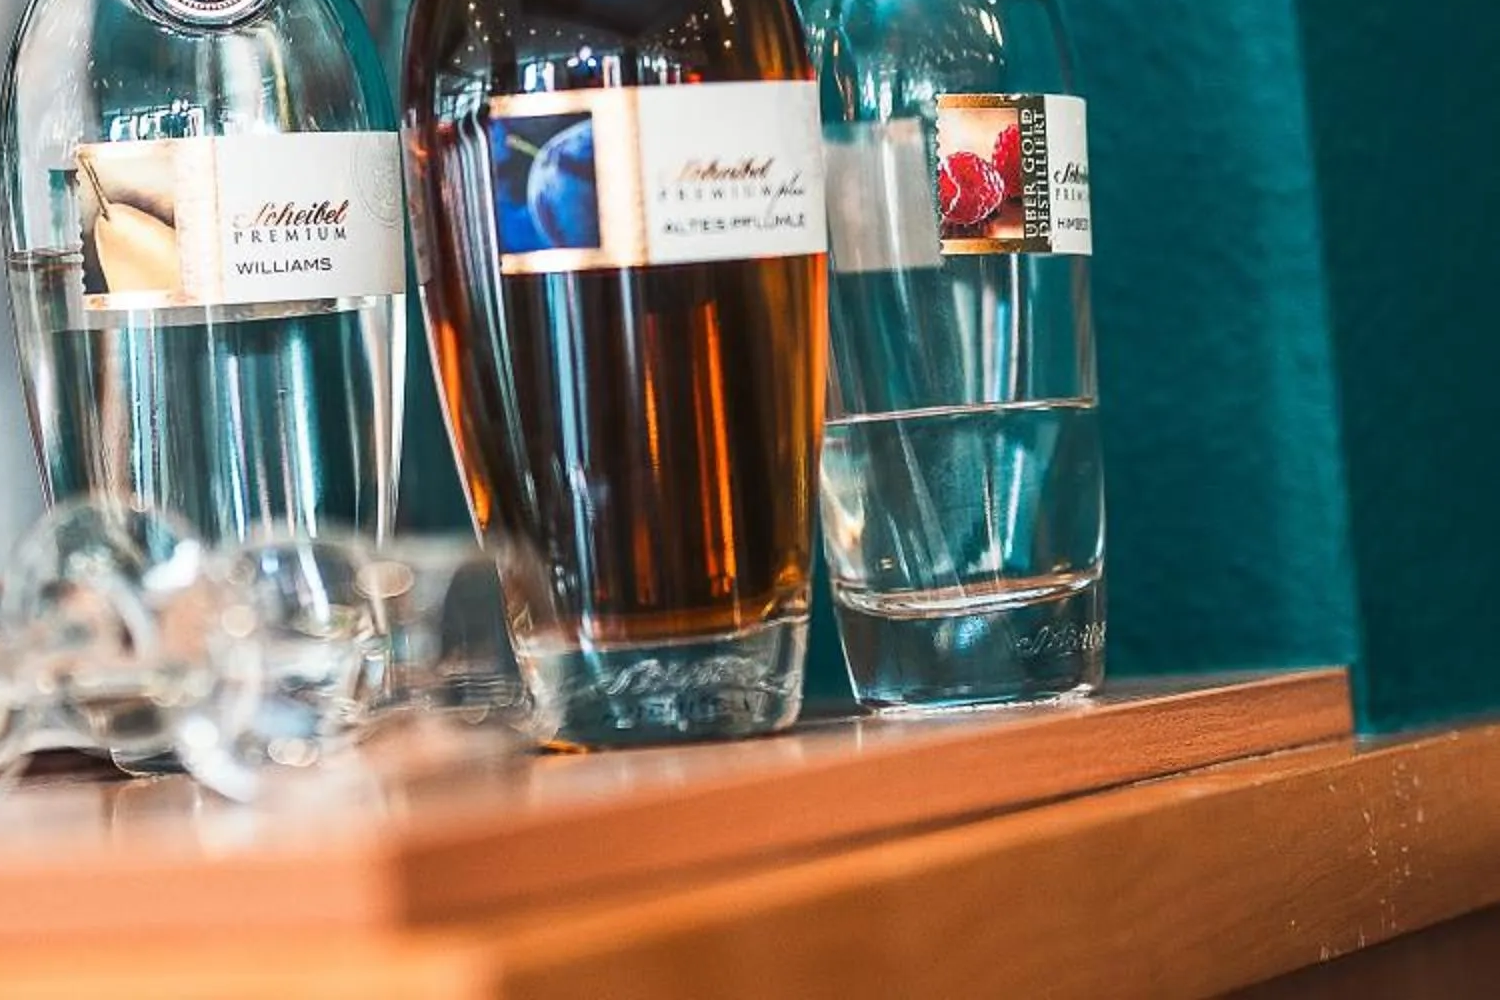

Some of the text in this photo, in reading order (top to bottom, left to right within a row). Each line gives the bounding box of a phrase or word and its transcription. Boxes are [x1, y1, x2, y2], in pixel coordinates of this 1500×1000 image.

[1021, 109, 1035, 173] GOLD
[233, 200, 349, 229] Scheibel
[233, 227, 348, 245] PREMIUM
[236, 258, 332, 275] WILLIAMS
